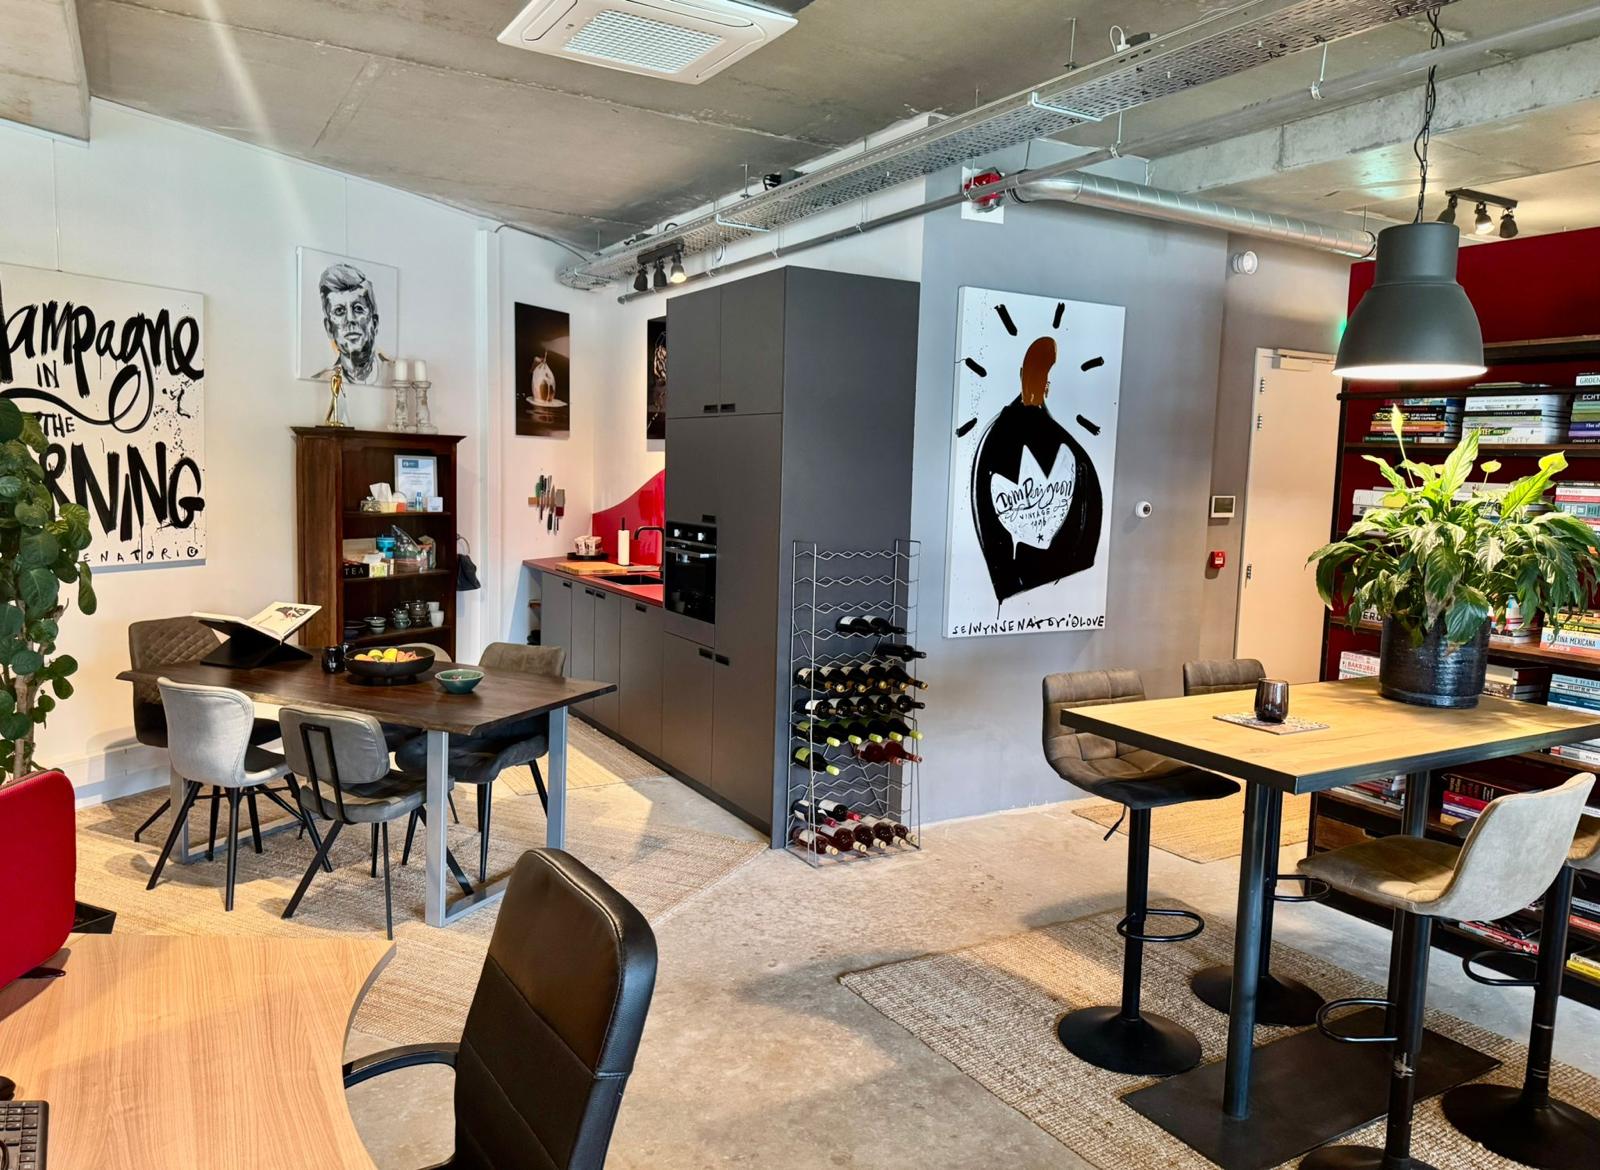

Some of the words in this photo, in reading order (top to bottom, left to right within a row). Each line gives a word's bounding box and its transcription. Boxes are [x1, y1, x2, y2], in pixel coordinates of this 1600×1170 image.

[37, 360, 60, 388] IN
[34, 411, 75, 437] THE
[39, 441, 205, 541] RNING
[1019, 508, 1050, 520] VINTAGE
[344, 567, 365, 576] TEA
